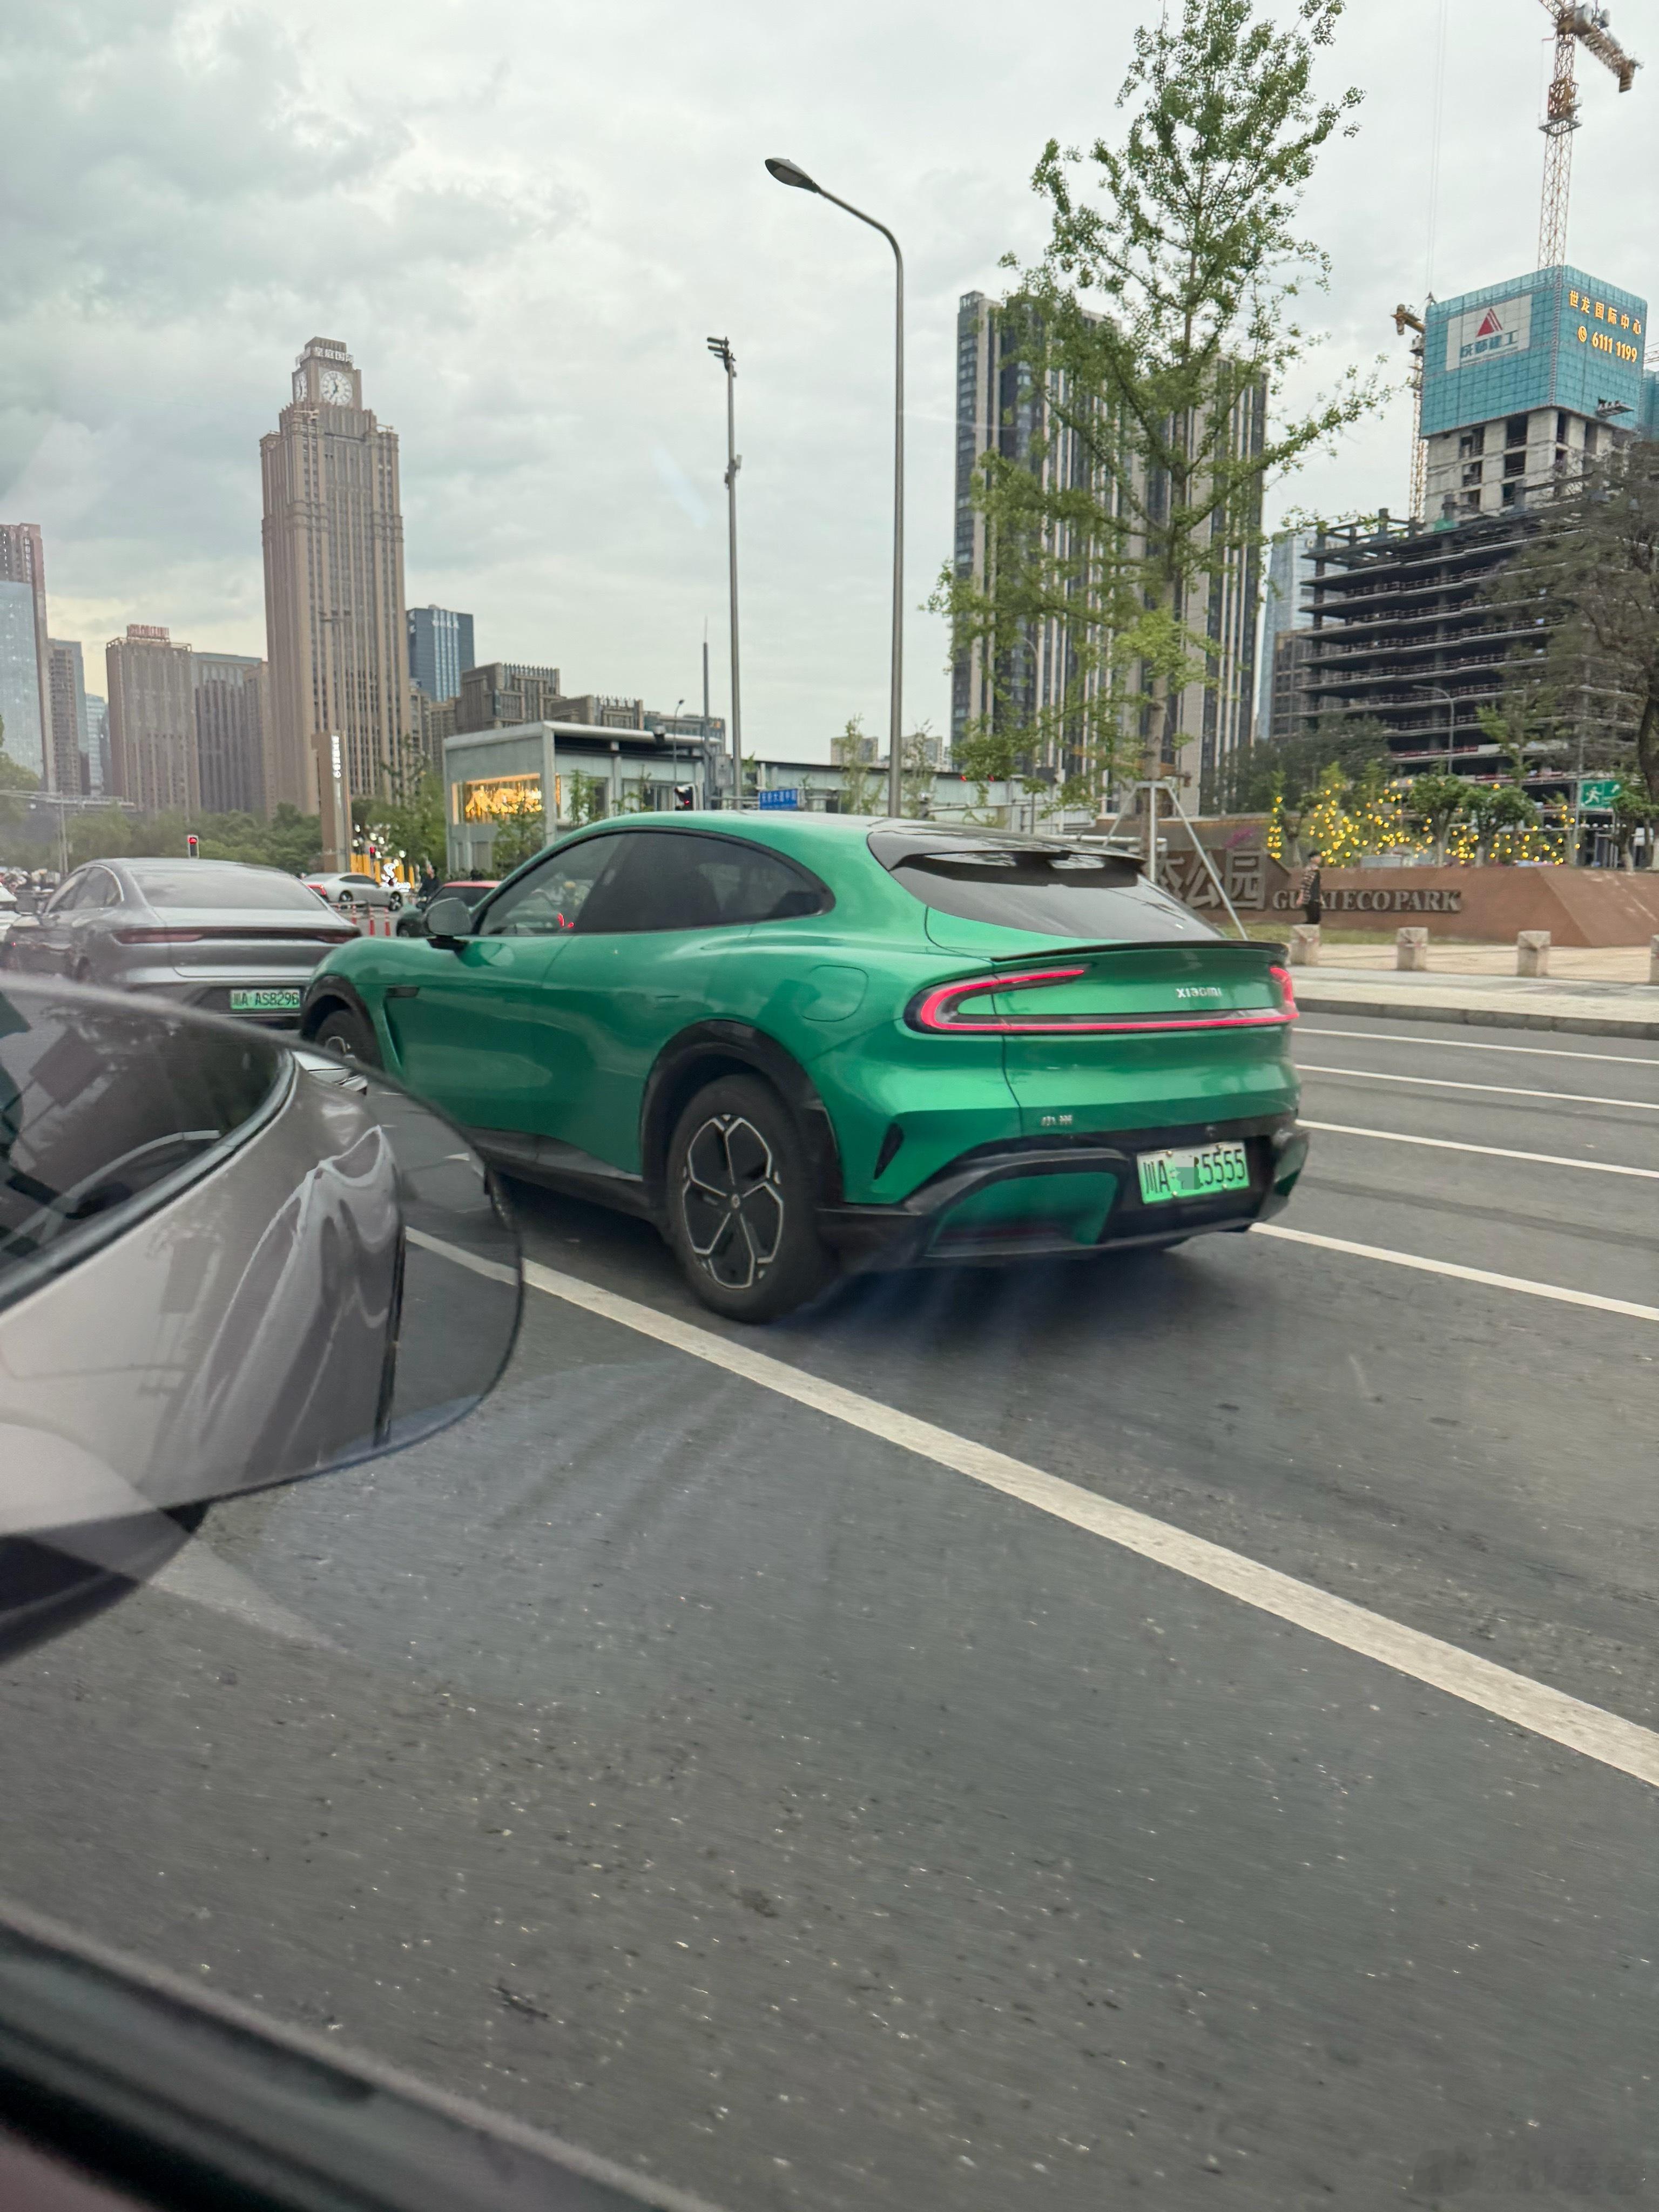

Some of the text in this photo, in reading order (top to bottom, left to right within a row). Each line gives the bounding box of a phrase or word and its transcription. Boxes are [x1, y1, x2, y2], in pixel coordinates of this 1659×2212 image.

[1569, 290, 1642, 335] 世龙国际中心
[1591, 331, 1637, 363] 6111 1199
[1341, 890, 1391, 910] ECO
[1394, 890, 1461, 912] PARK
